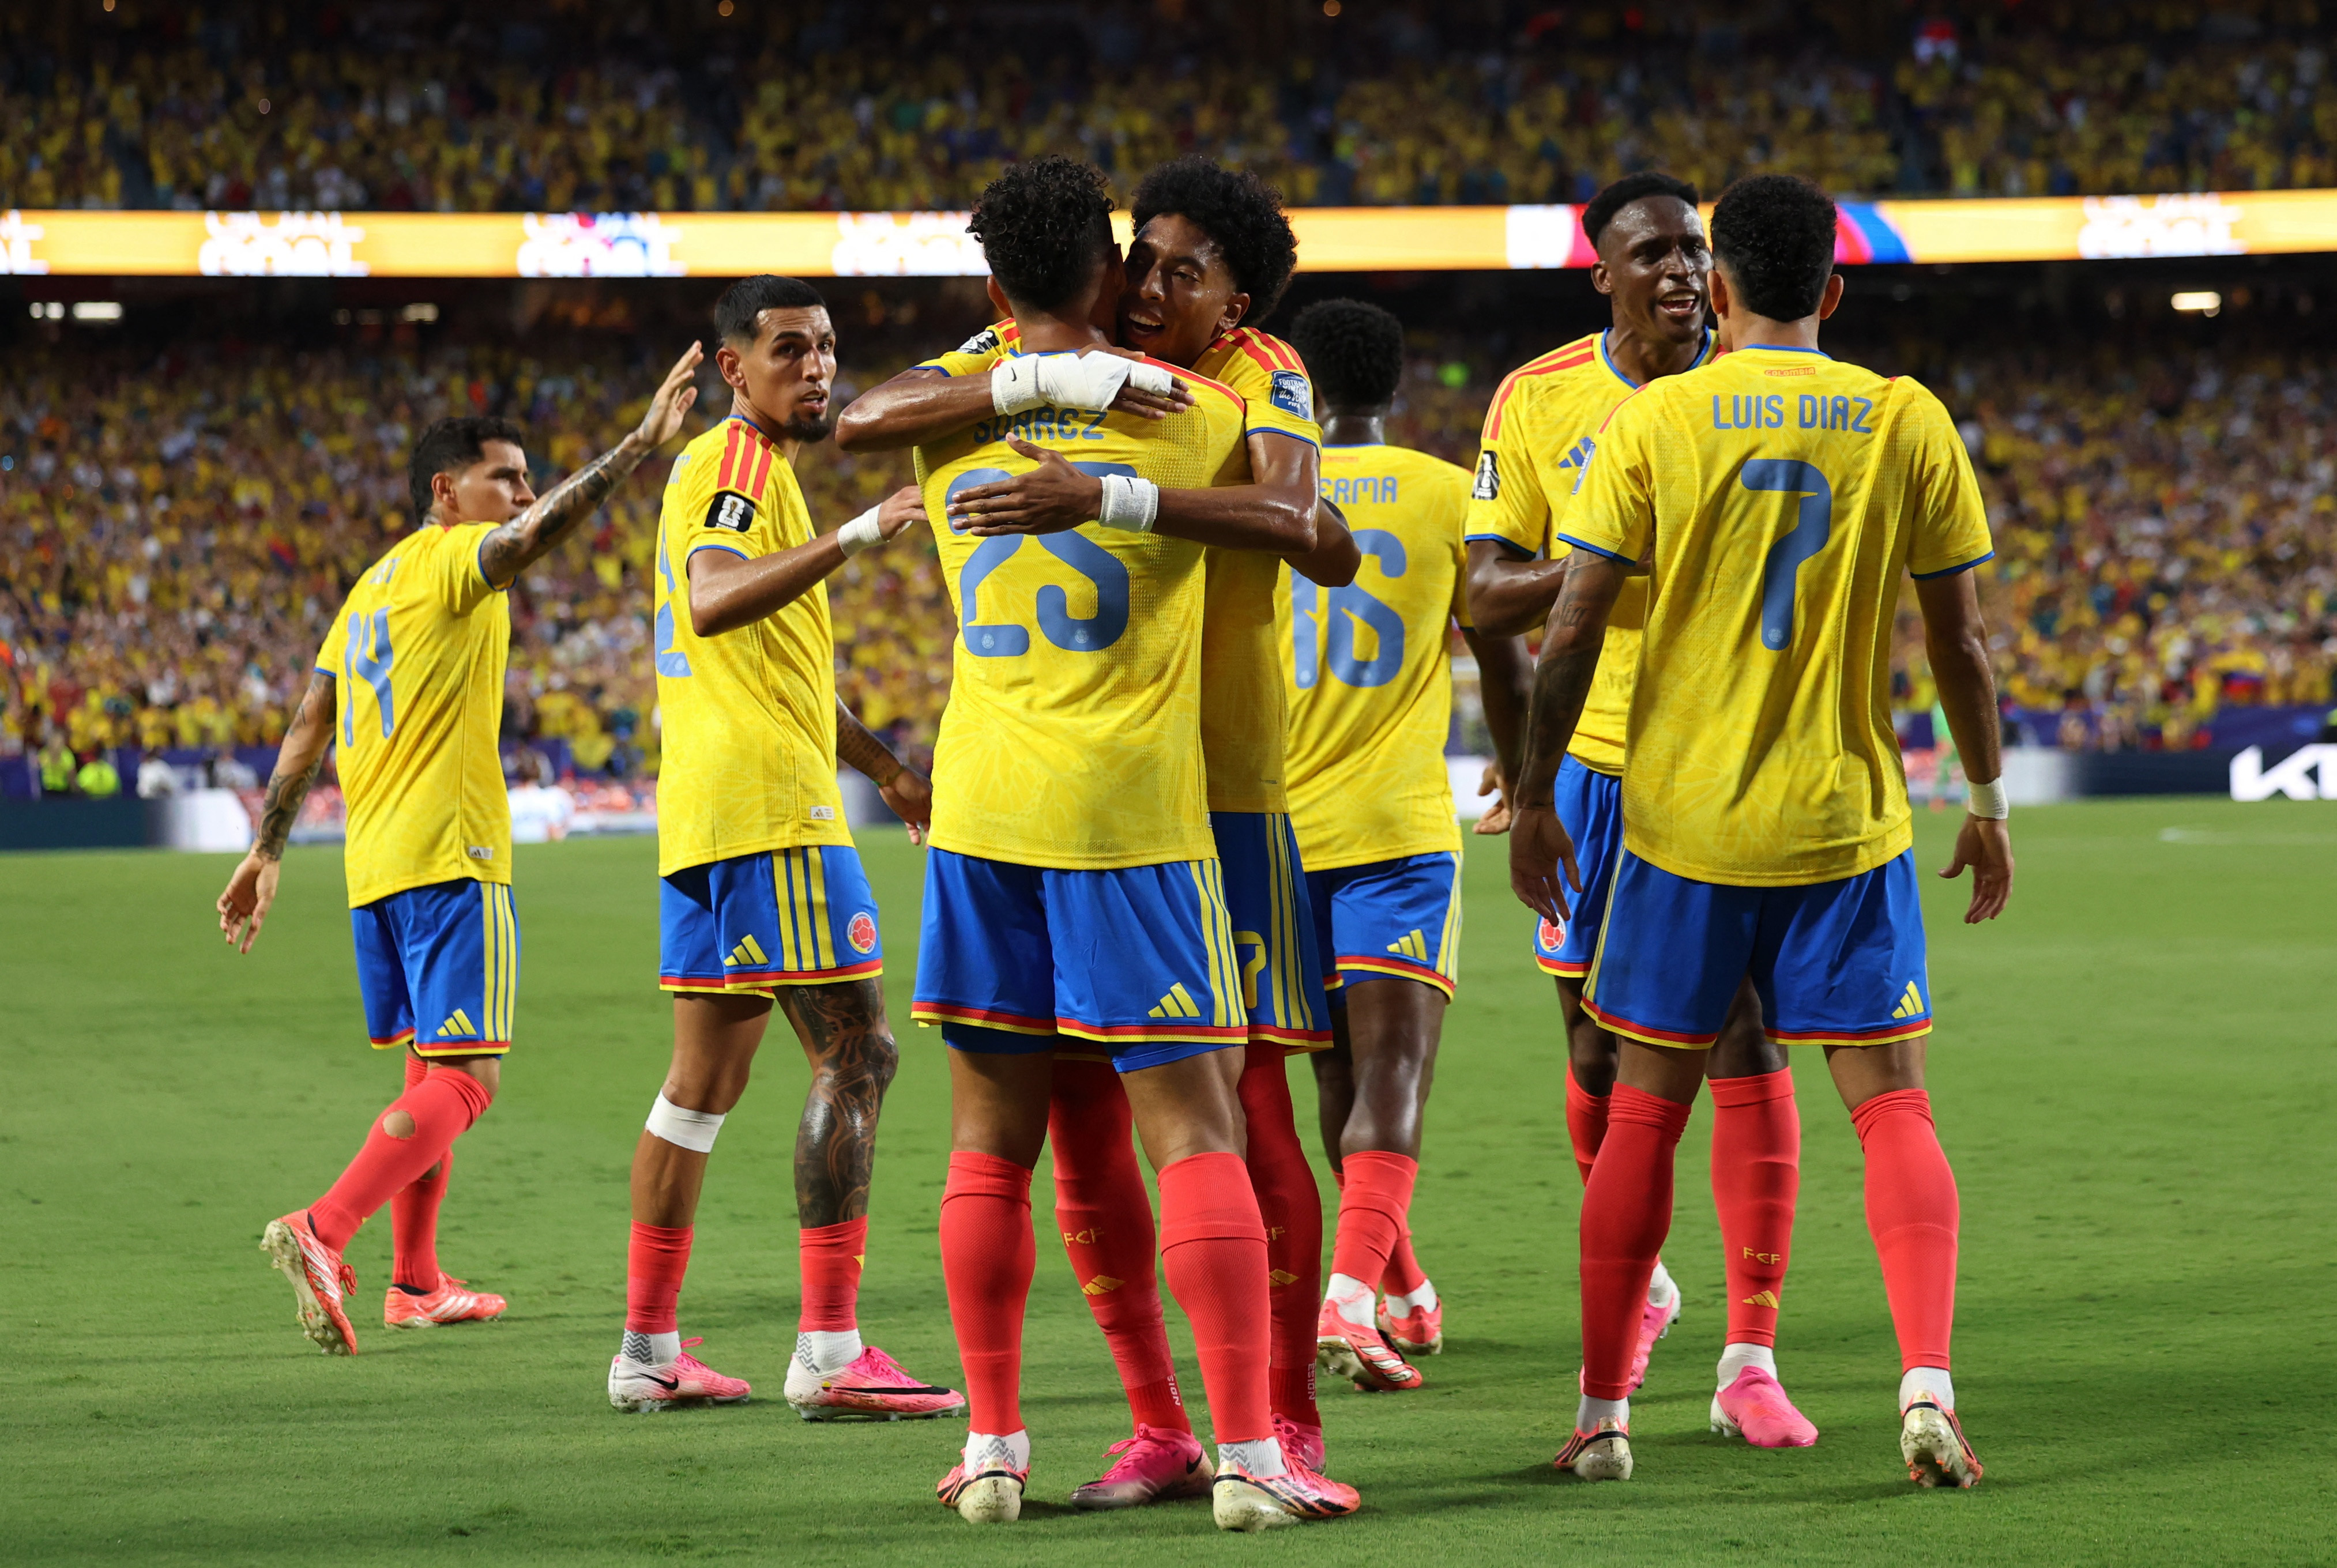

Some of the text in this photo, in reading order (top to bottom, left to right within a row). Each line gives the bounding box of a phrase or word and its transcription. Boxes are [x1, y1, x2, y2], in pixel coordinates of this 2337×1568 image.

[974, 407, 1108, 443] SUAREZ
[1713, 394, 1873, 434] LUIS DIAZ
[1319, 477, 1398, 504] ERMA
[1741, 459, 1831, 650] 7
[1290, 529, 1406, 689] 16
[344, 605, 394, 748] 14
[2229, 743, 2337, 802] KI
[1063, 1227, 1104, 1247] FCF
[1743, 1246, 1781, 1265] FCF
[1166, 1374, 1181, 1406] SIGN
[1307, 1362, 1316, 1400] ESIGN
